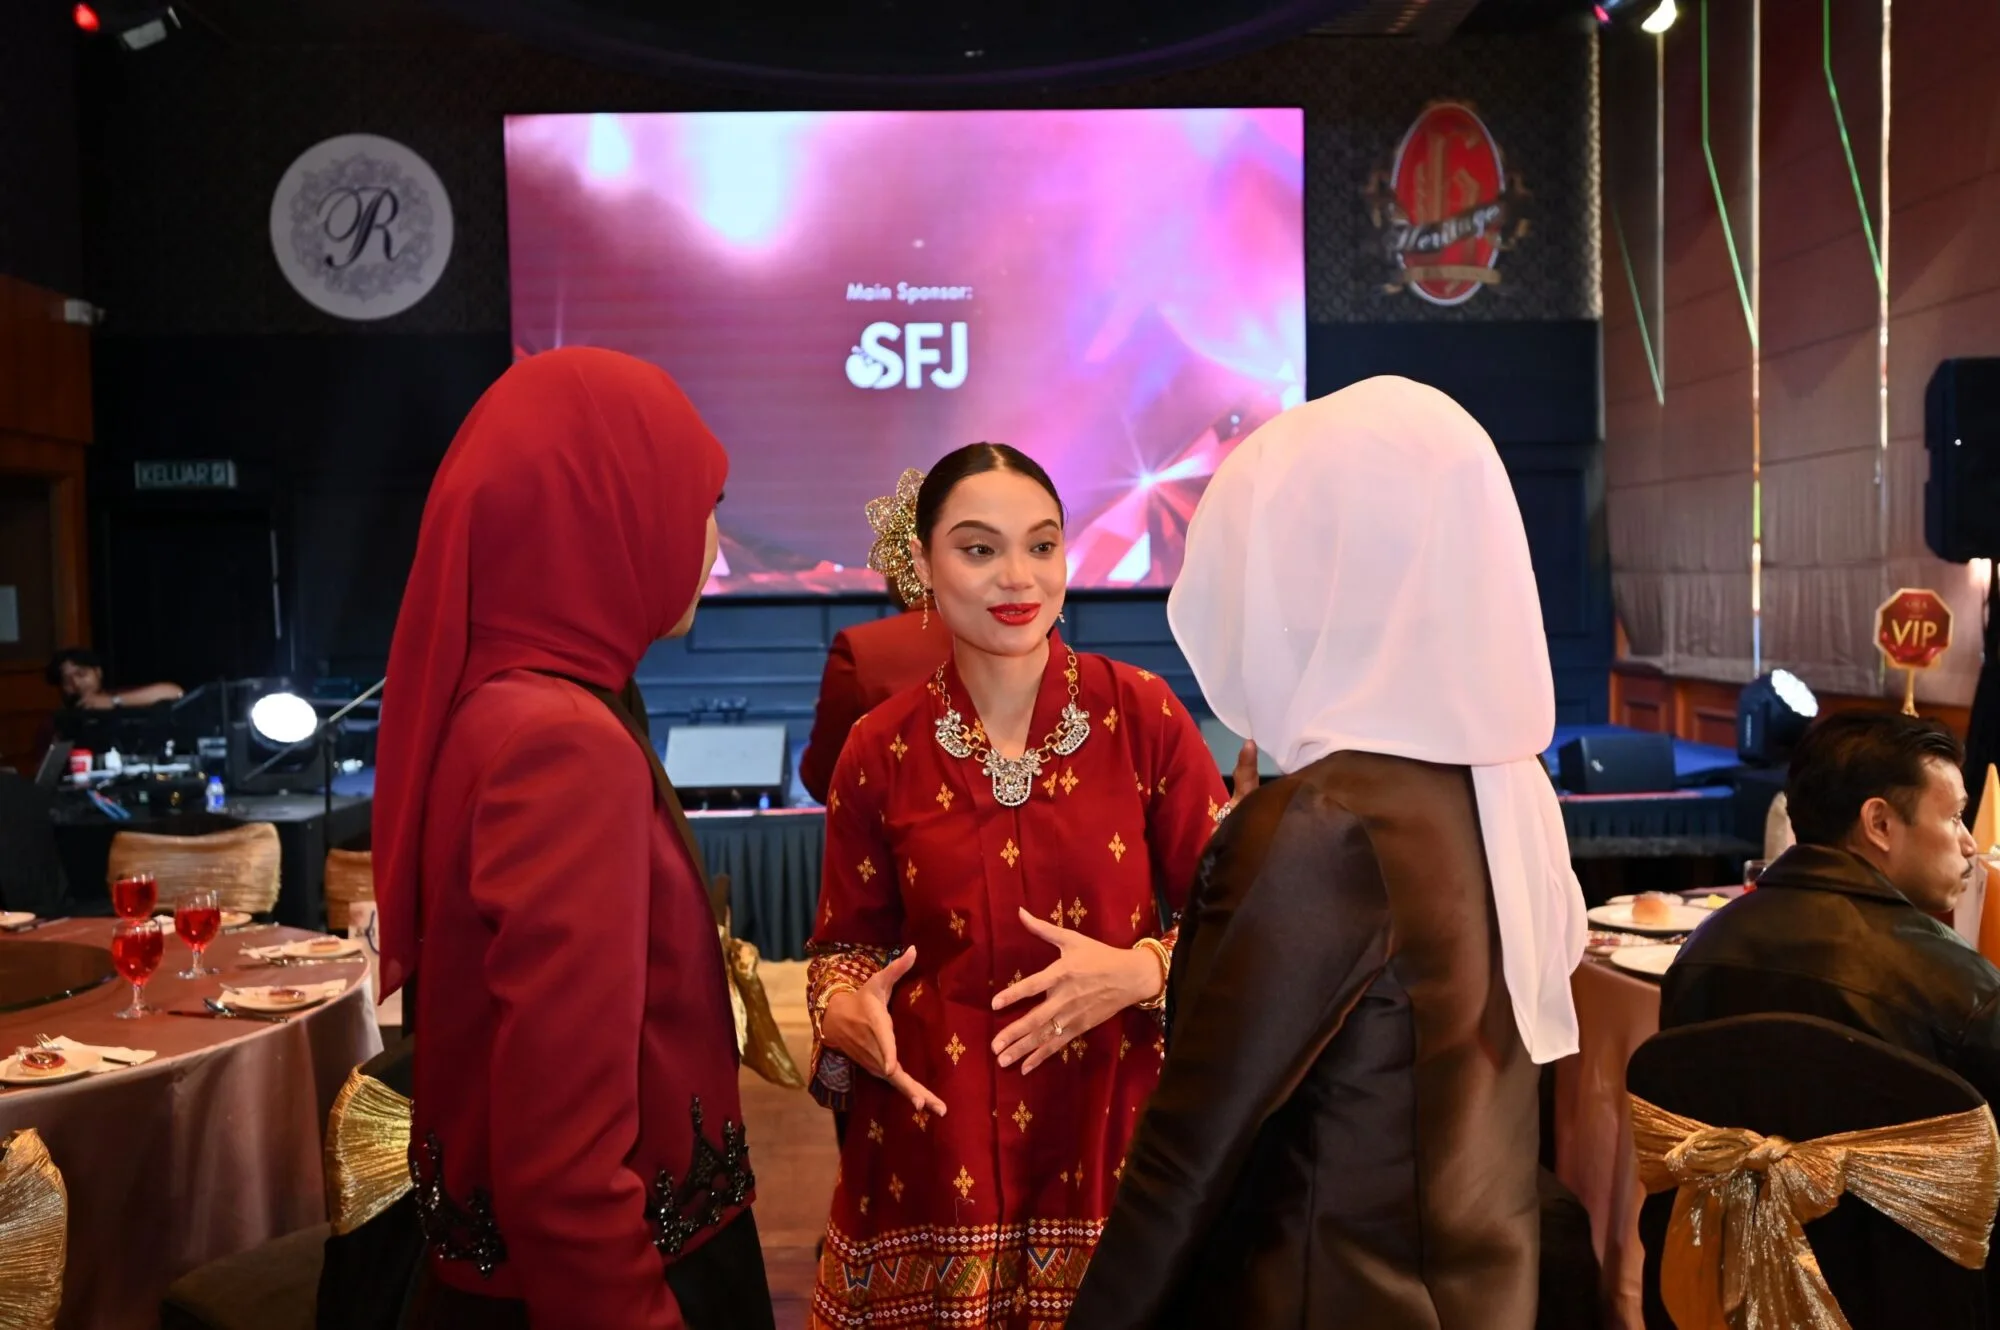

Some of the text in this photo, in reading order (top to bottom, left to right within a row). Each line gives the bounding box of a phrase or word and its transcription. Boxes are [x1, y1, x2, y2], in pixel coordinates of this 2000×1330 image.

[846, 281, 973, 305] Main Sponsor:
[857, 321, 969, 389] SFJ
[141, 463, 209, 485] KELUAR
[1891, 618, 1938, 649] VIP
